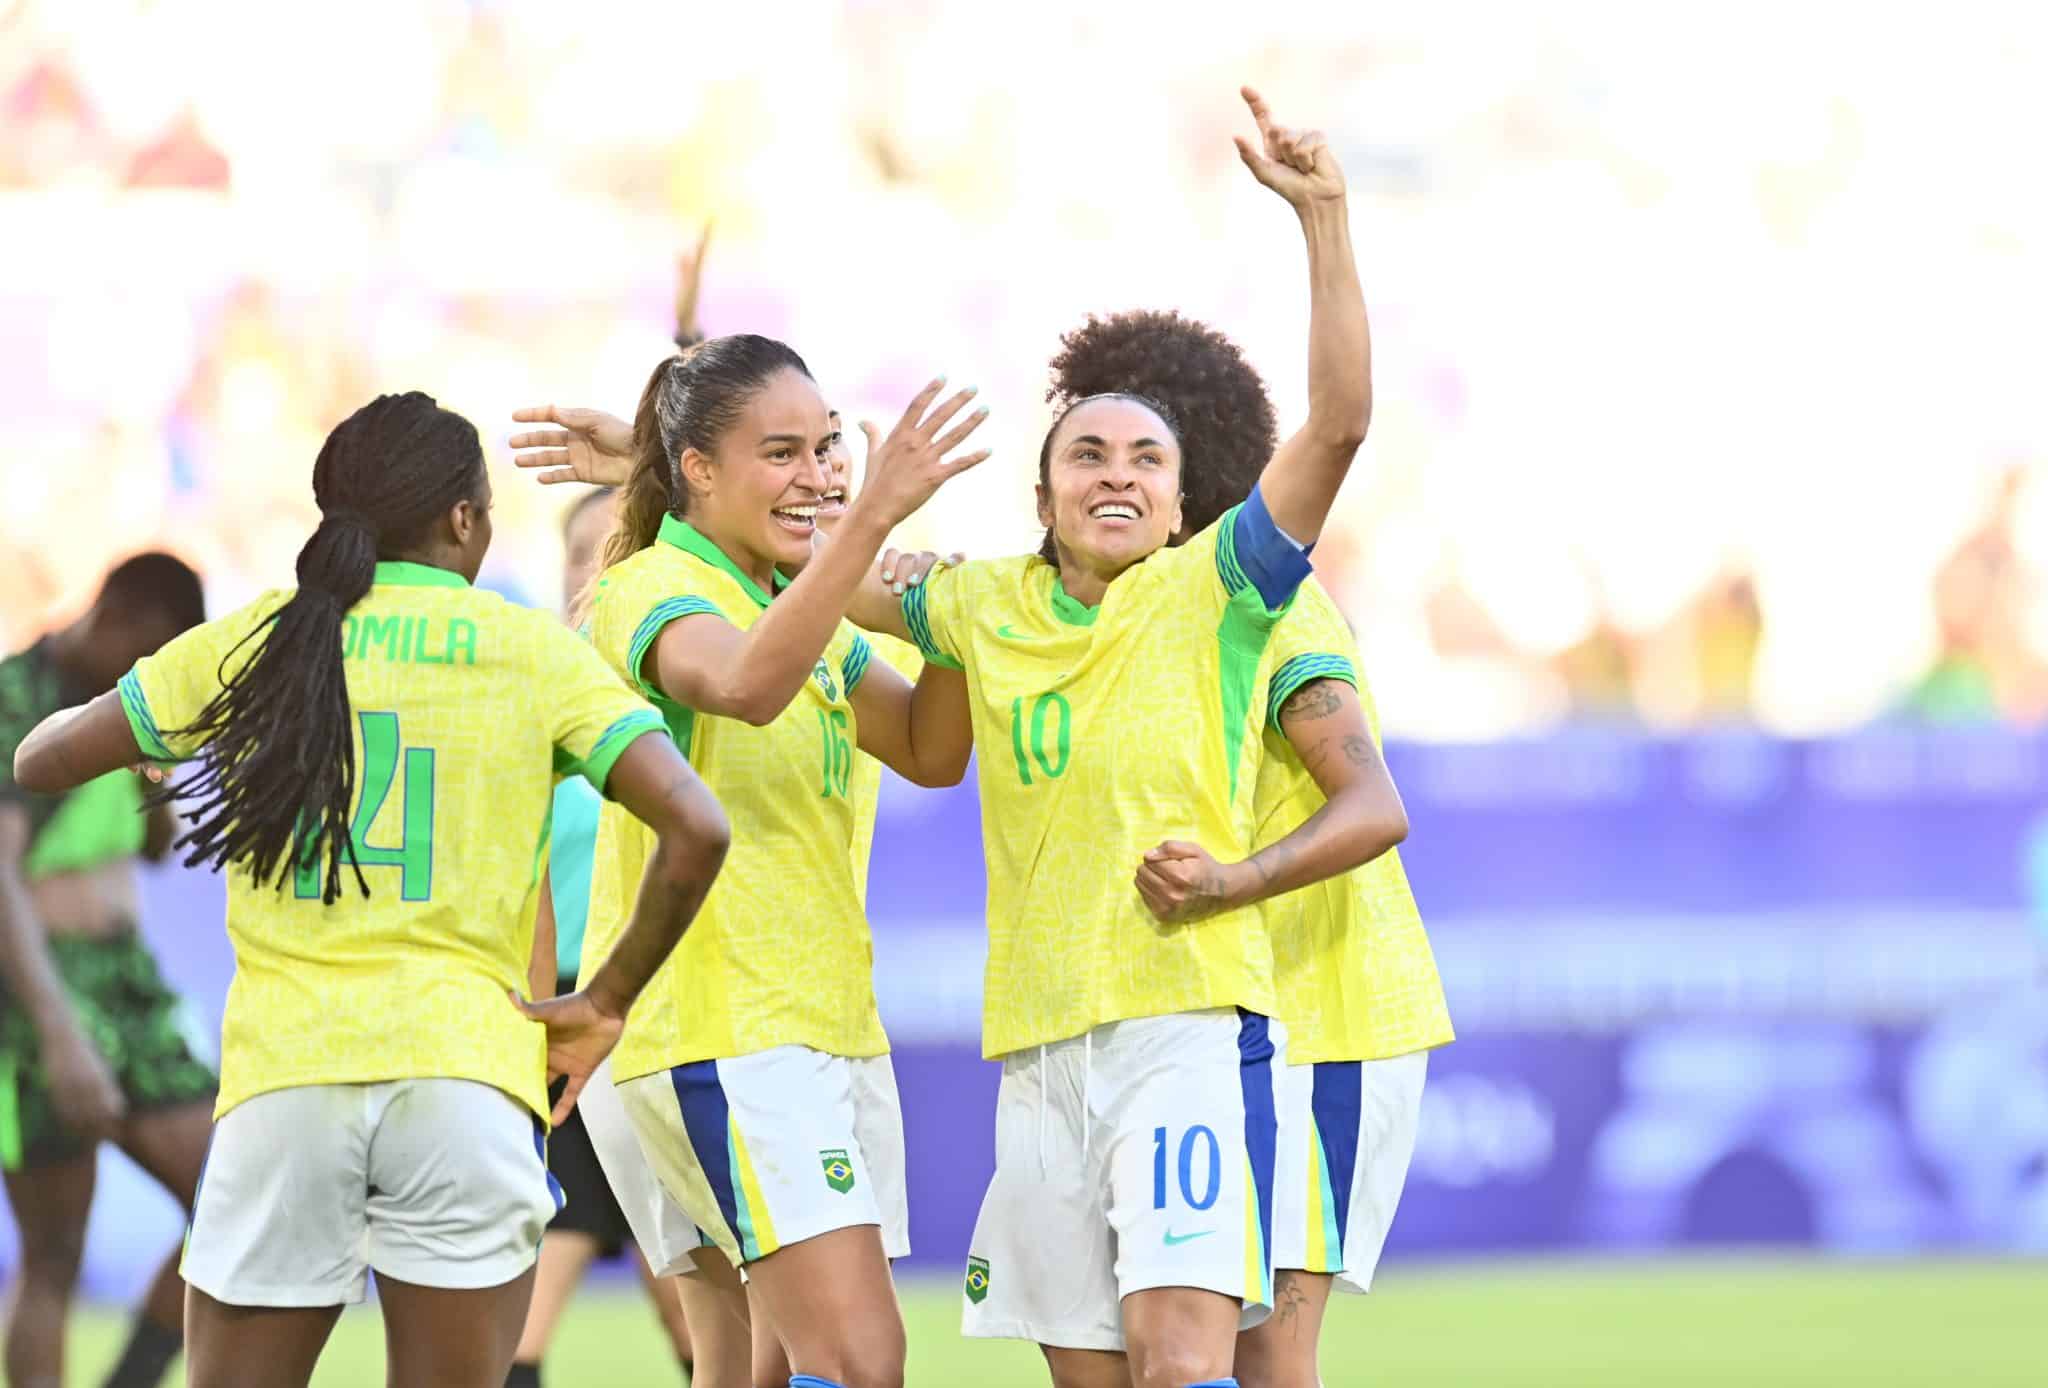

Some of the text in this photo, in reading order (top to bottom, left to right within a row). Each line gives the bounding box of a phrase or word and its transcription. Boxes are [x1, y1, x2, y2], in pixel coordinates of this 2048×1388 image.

[816, 707, 851, 799] 16
[1012, 690, 1071, 785] 10
[1153, 1124, 1221, 1211] 10
